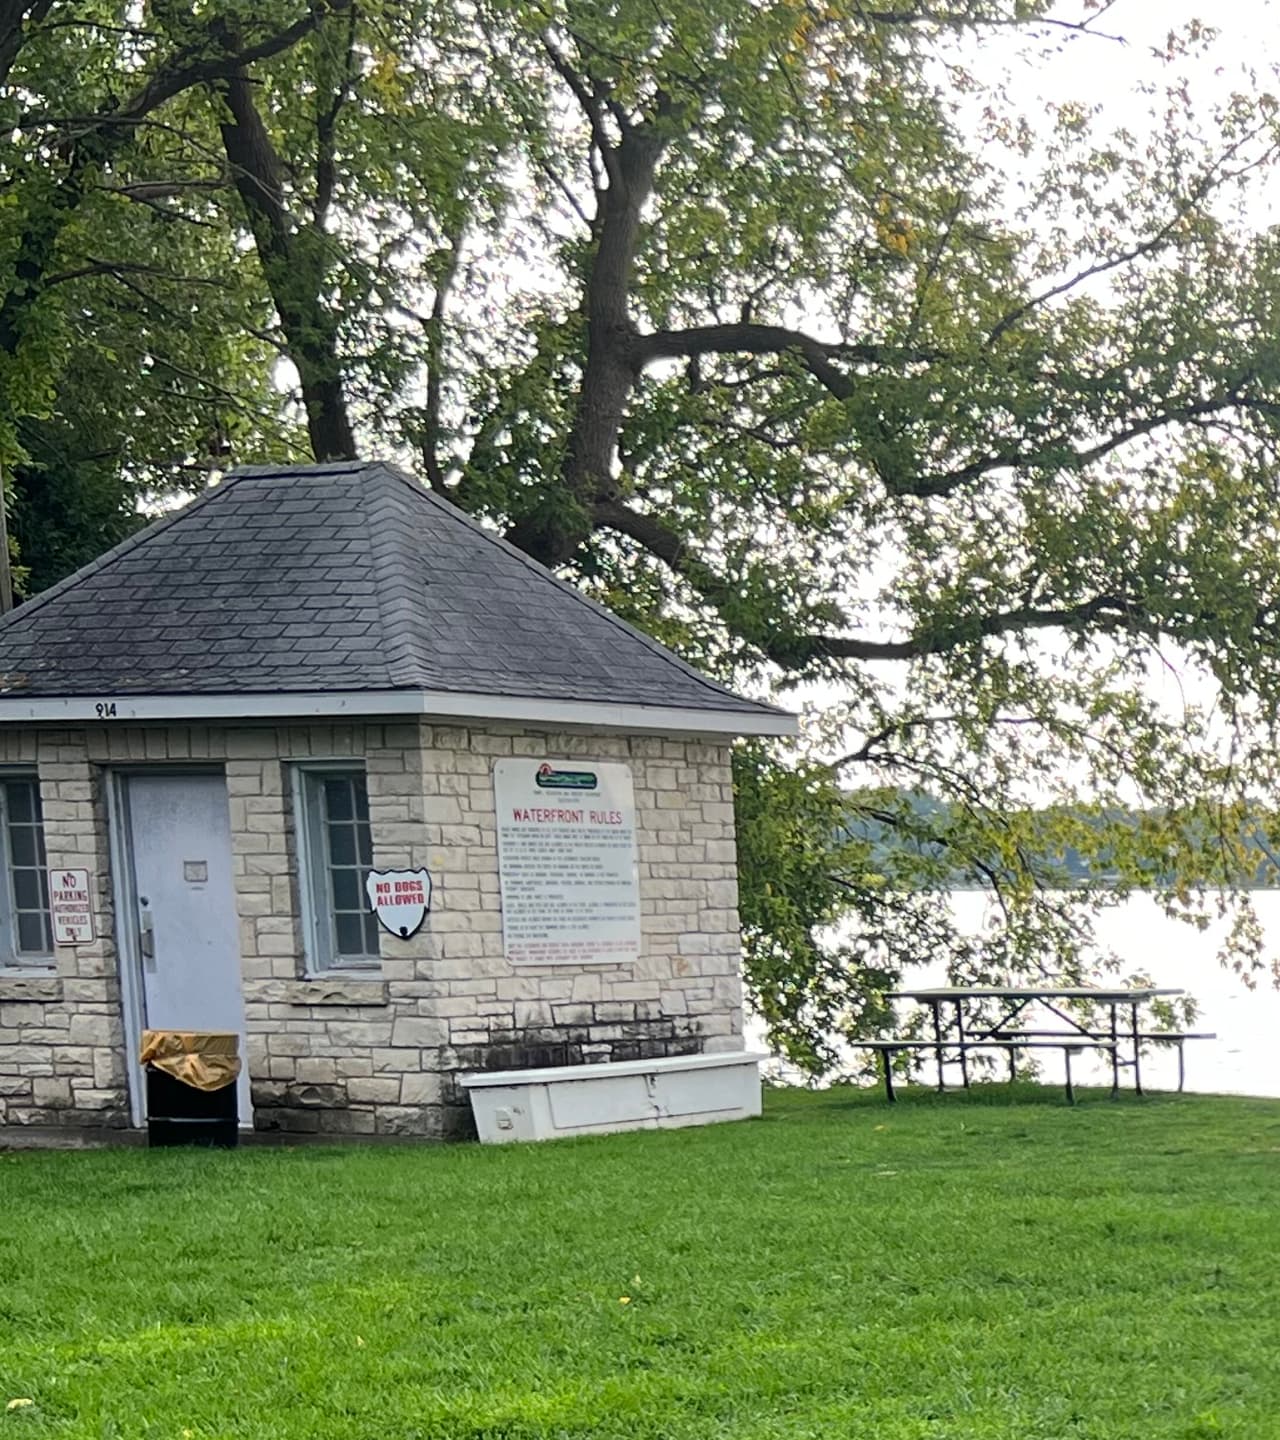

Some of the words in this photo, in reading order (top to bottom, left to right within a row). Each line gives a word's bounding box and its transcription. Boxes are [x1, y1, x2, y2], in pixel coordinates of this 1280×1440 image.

[95, 703, 117, 717] 914
[513, 808, 584, 823] WATERFRONT
[590, 811, 622, 824] RULES
[63, 872, 76, 888] NO
[376, 883, 390, 893] NO
[395, 881, 423, 892] DOGS
[54, 890, 87, 901] PARKING
[377, 894, 424, 906] ALLOWED
